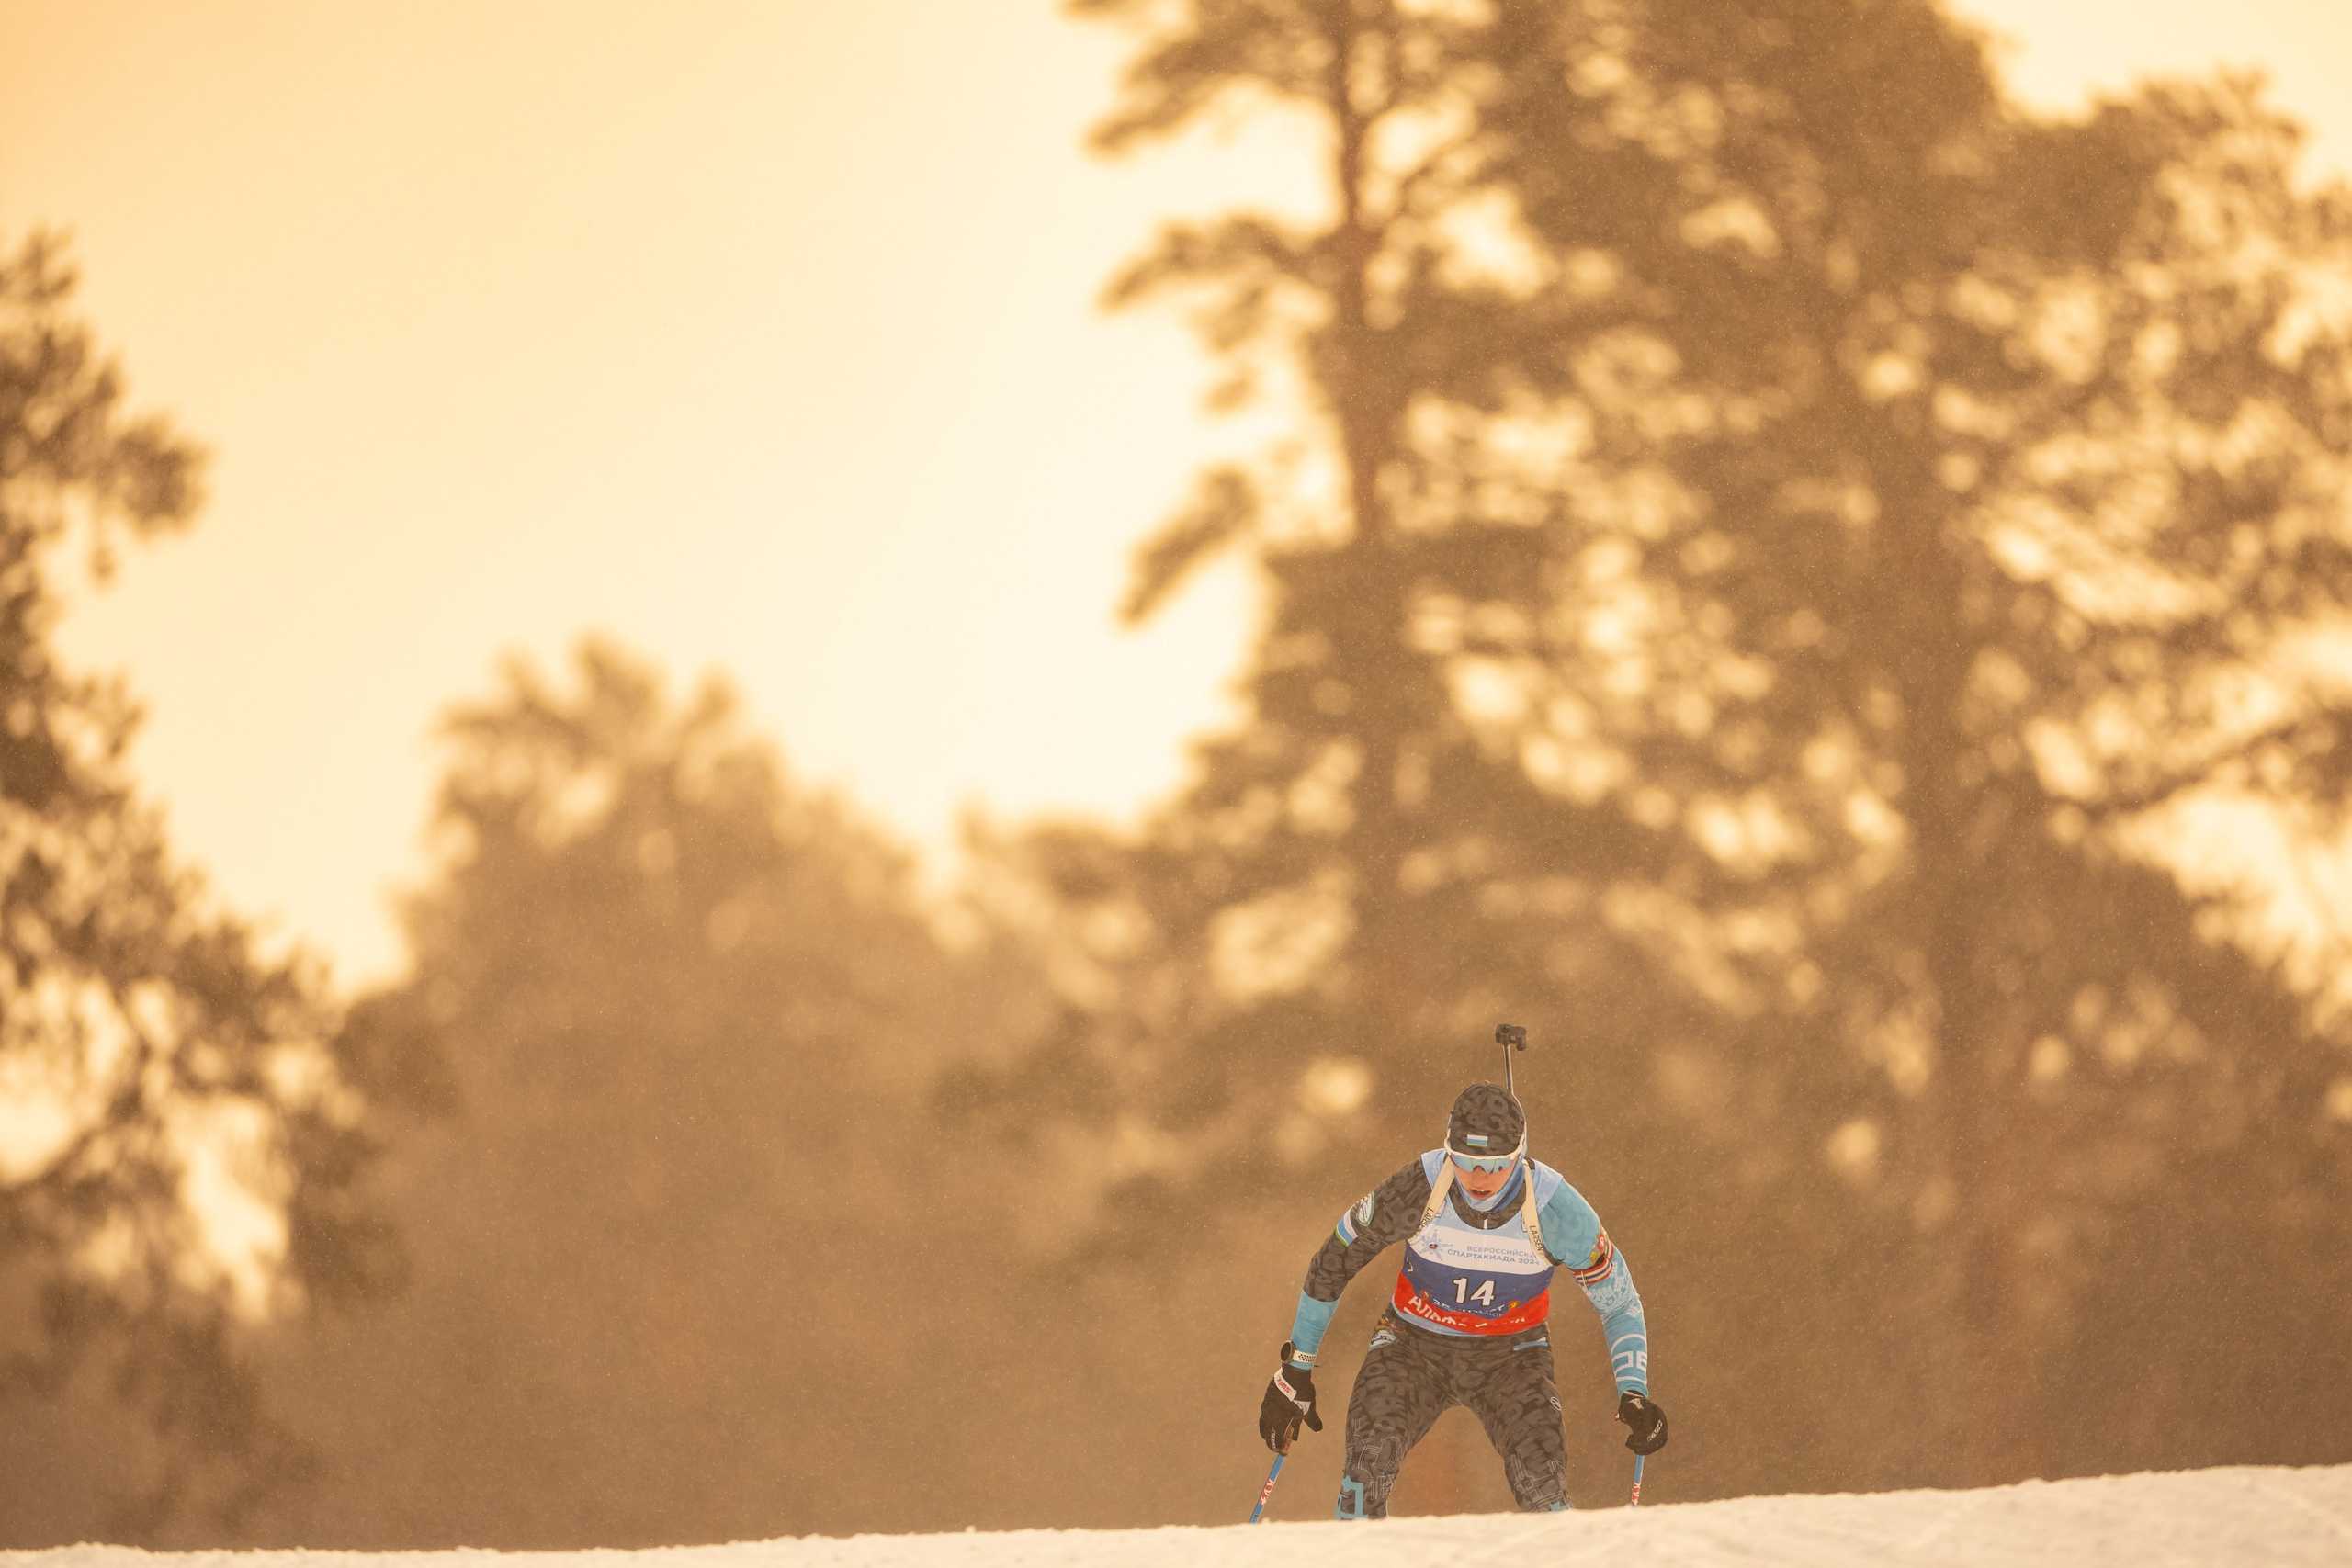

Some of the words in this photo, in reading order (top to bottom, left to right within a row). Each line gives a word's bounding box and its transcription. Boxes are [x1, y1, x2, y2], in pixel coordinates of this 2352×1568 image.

[1529, 1225, 1544, 1251] LARSEN
[1447, 1248, 1516, 1263] СПАРТАКИАДА
[1453, 1276, 1497, 1307] 14
